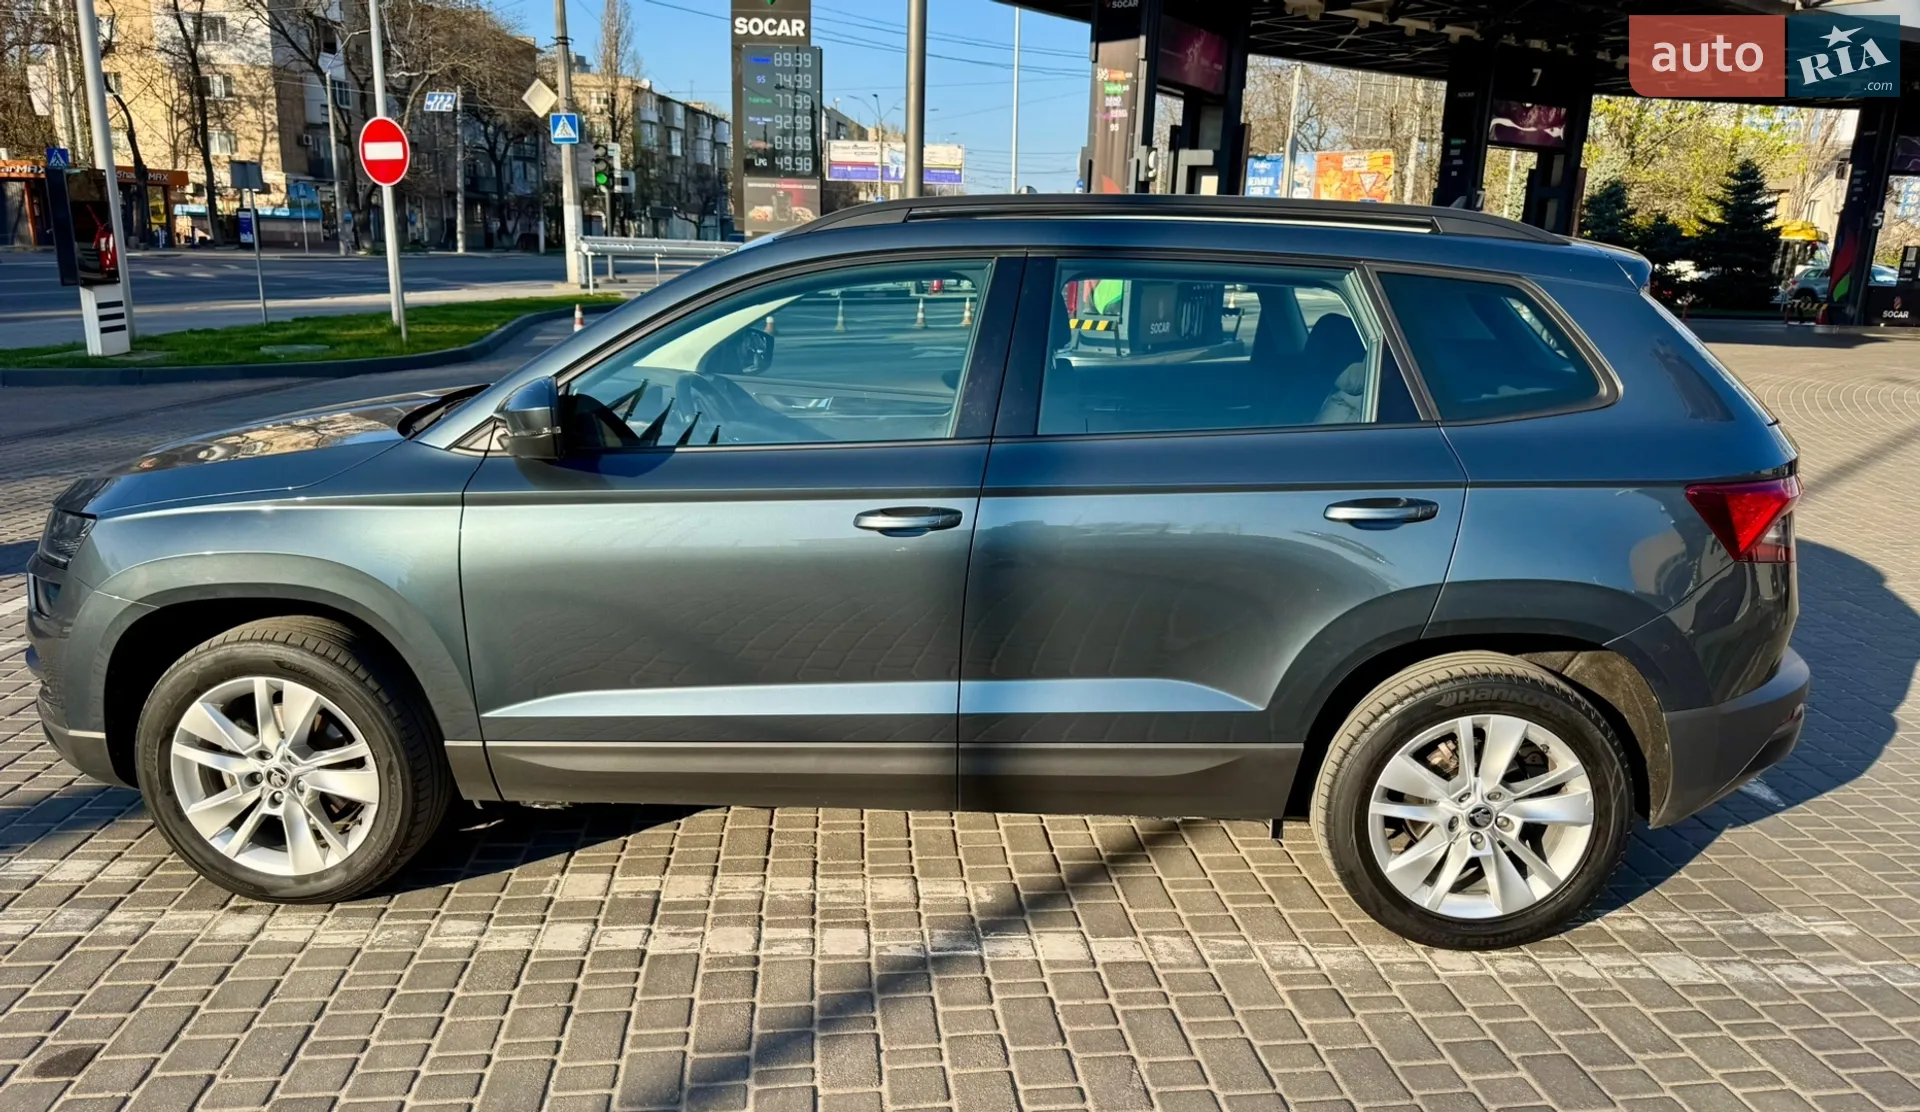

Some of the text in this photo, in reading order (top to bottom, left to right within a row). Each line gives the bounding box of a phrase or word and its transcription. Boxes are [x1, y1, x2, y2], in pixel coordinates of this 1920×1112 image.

[734, 17, 805, 36] SOCAR
[774, 52, 812, 68] 89.99
[756, 73, 812, 89] 95 74.99
[1531, 68, 1542, 87] 7
[775, 94, 812, 109] 77.99
[774, 114, 812, 130] 92.99
[1109, 123, 1119, 131] 95
[774, 136, 812, 151] 84.99
[754, 156, 812, 171] LPG 49.98
[1872, 212, 1883, 227] 5
[1882, 310, 1909, 319] SOCAR
[1150, 321, 1170, 335] SOCAR
